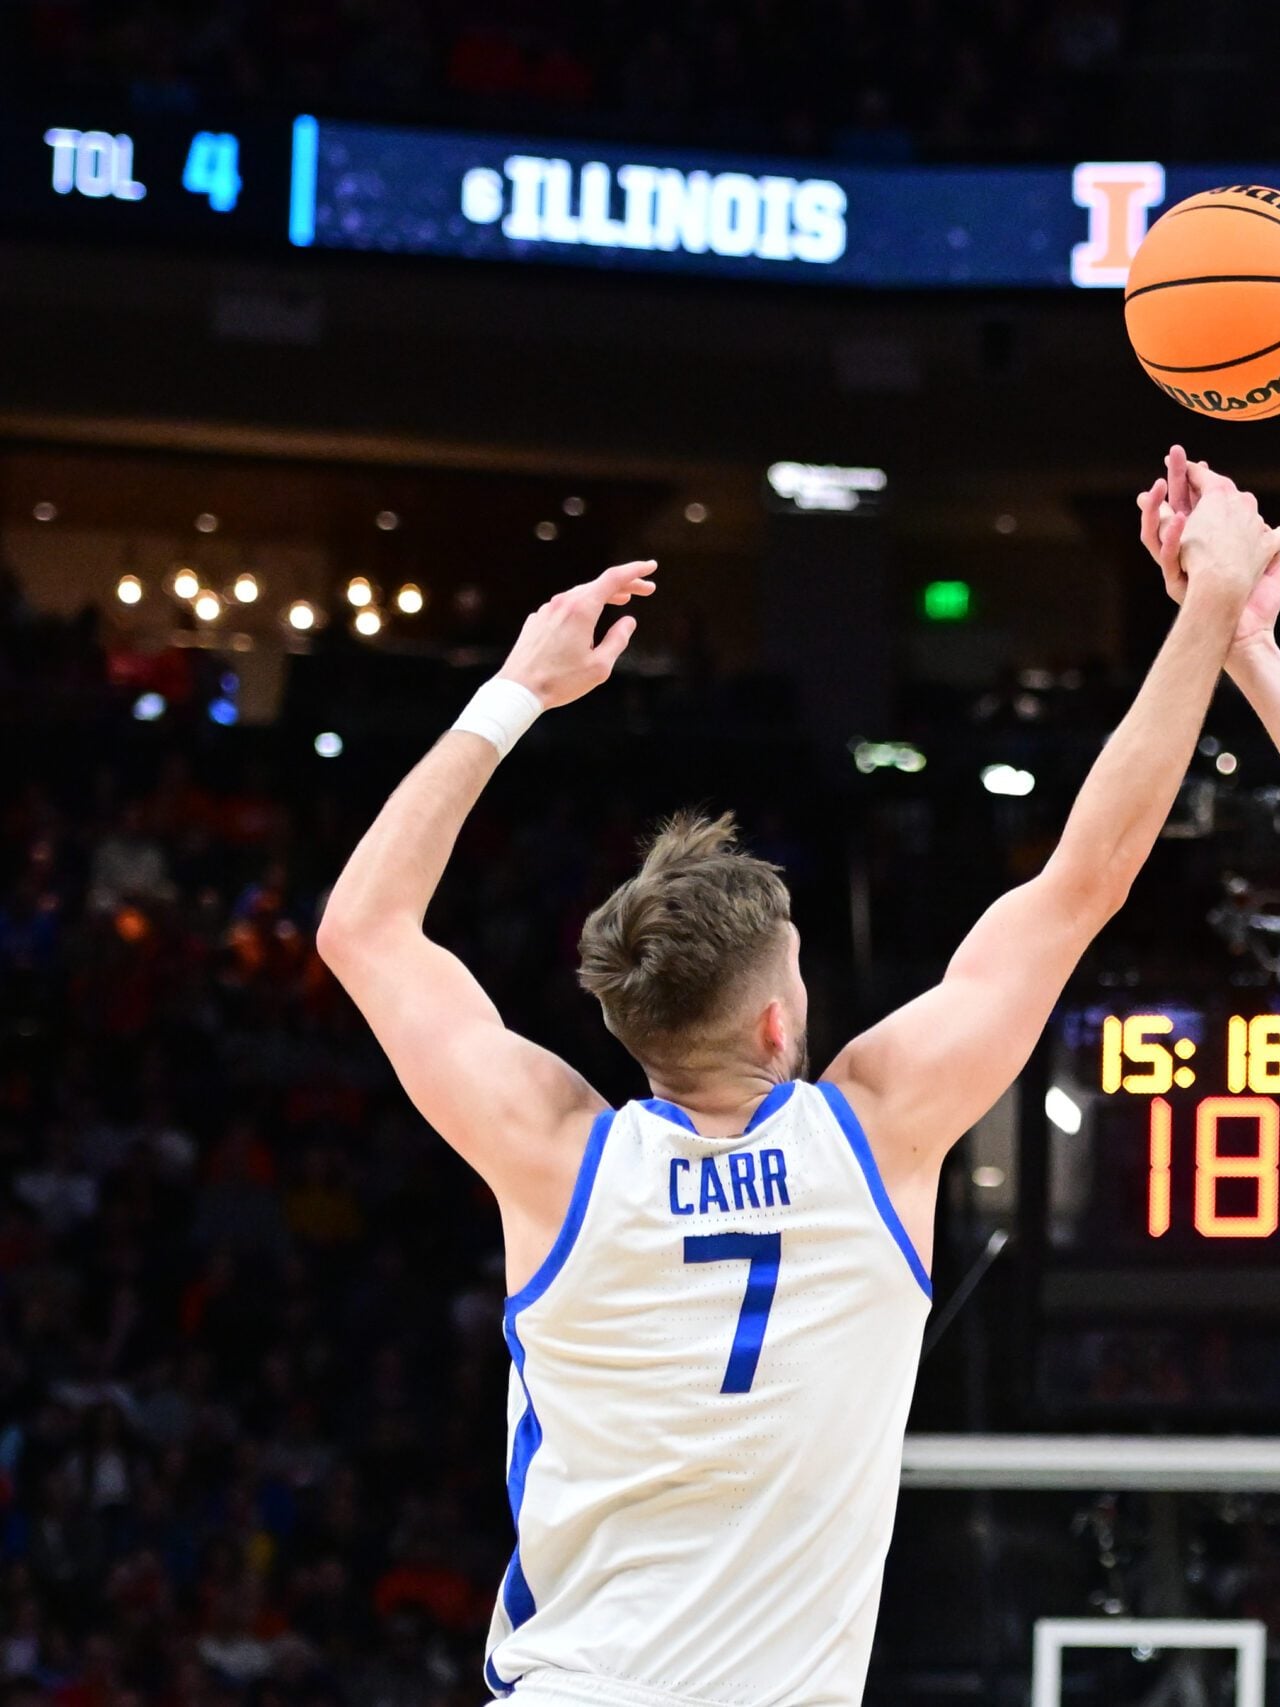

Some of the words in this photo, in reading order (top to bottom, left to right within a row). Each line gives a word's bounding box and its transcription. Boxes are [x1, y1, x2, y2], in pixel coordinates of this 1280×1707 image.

[44, 128, 147, 201] TOL
[182, 131, 242, 212] 4
[502, 154, 848, 265] ILLINOIS
[669, 1148, 791, 1215] CARR
[1149, 1096, 1280, 1238] 18
[683, 1232, 781, 1394] 7
